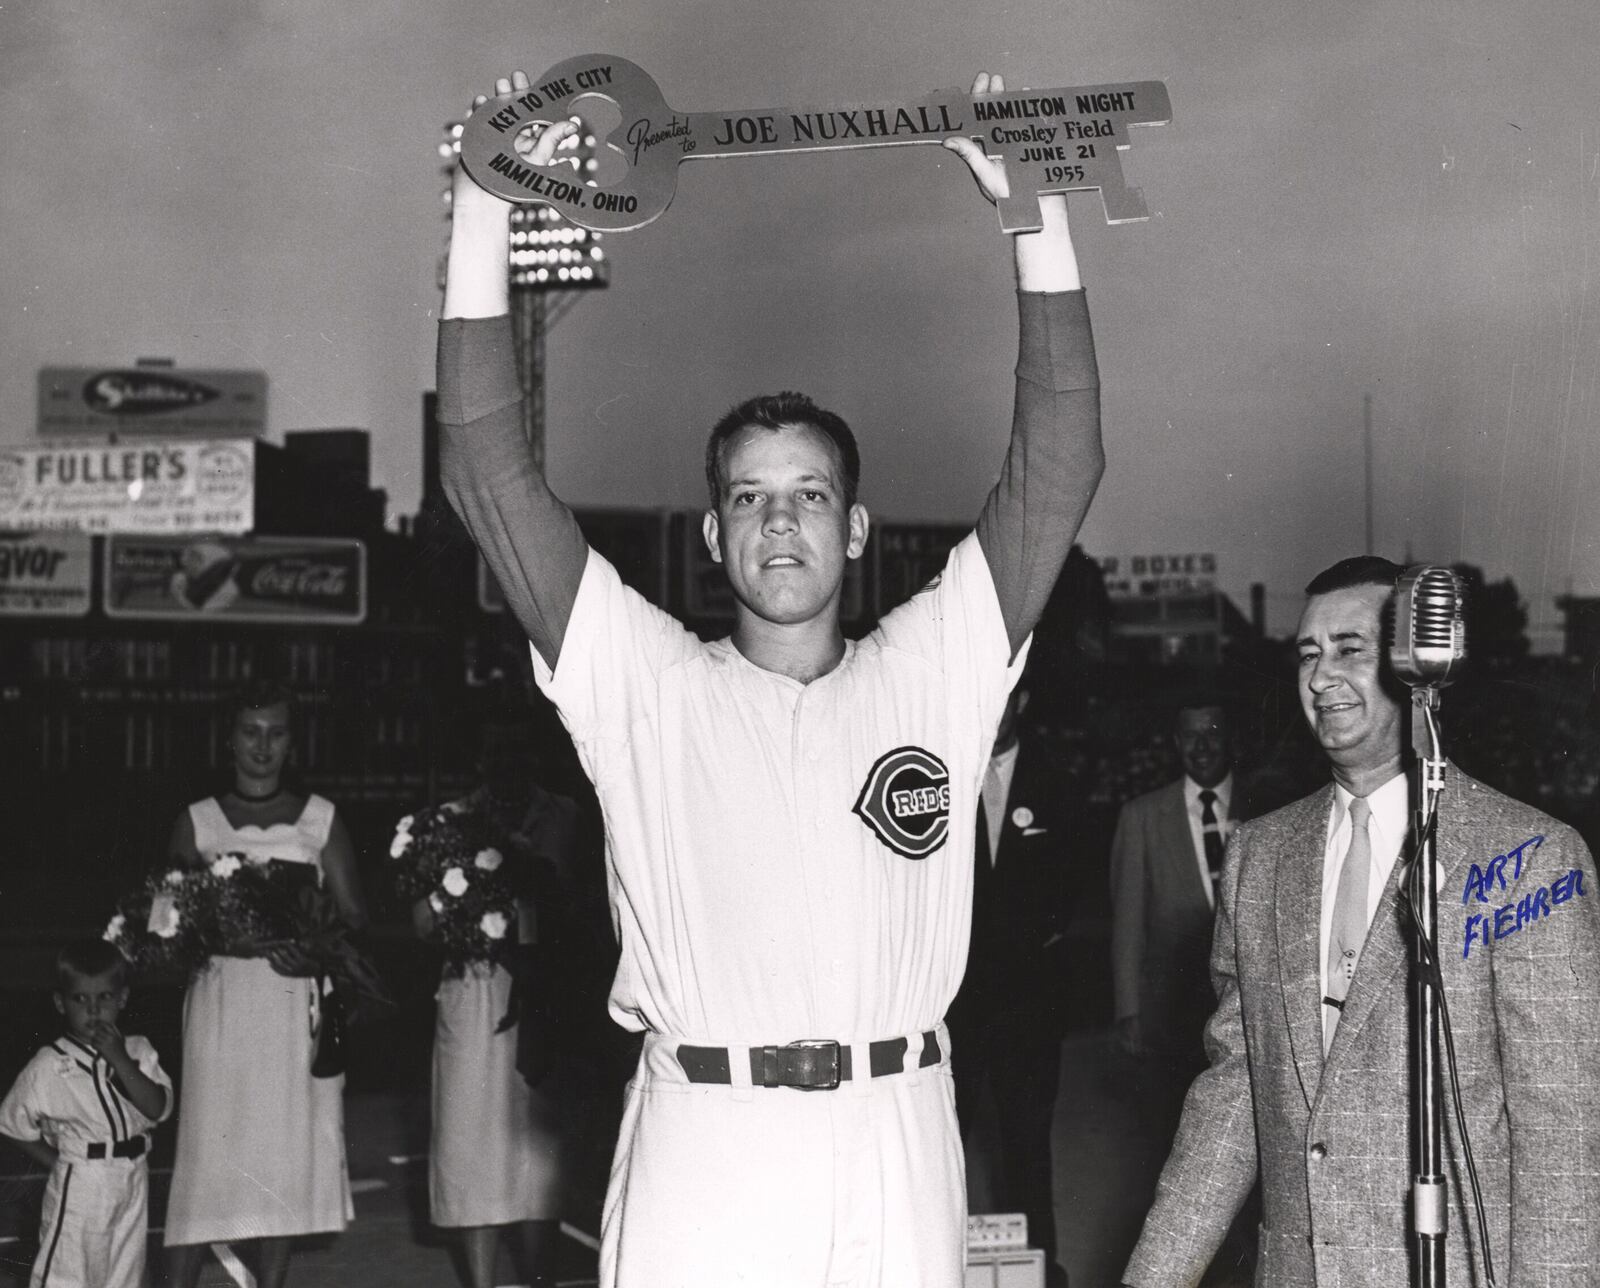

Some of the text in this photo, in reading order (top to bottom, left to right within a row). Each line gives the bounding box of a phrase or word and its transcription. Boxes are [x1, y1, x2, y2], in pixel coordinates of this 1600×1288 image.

[488, 66, 613, 134] KEY TO THE CITY
[973, 92, 1135, 122] HAMILTON NIGHT
[627, 116, 692, 167] Presented
[713, 105, 963, 146] JOE NUXHALL
[991, 119, 1115, 145] Crosley Field
[678, 137, 697, 153] to
[1019, 144, 1097, 163] JUNE 21
[488, 152, 638, 213] HAMILTON, OHIO
[1044, 165, 1085, 183] 1955
[36, 450, 187, 485] FULLER'S
